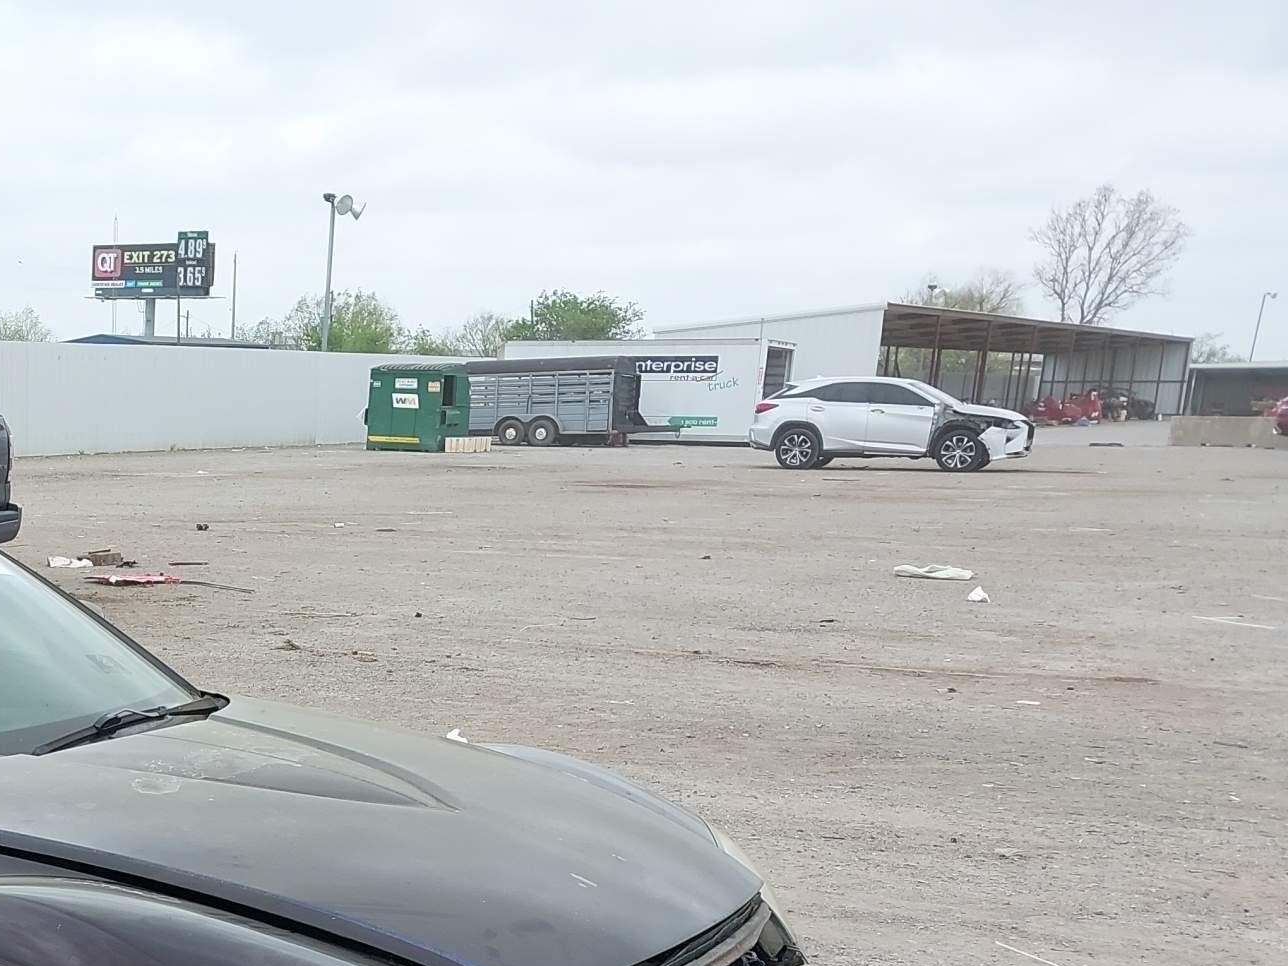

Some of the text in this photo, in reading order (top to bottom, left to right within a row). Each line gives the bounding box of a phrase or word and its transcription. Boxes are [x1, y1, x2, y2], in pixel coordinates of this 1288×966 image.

[97, 252, 117, 272] QT
[123, 250, 176, 263] EXIT 273
[145, 266, 163, 274] MILES
[635, 357, 717, 375] nterprise
[707, 376, 740, 392] truck
[395, 397, 417, 406] WM
